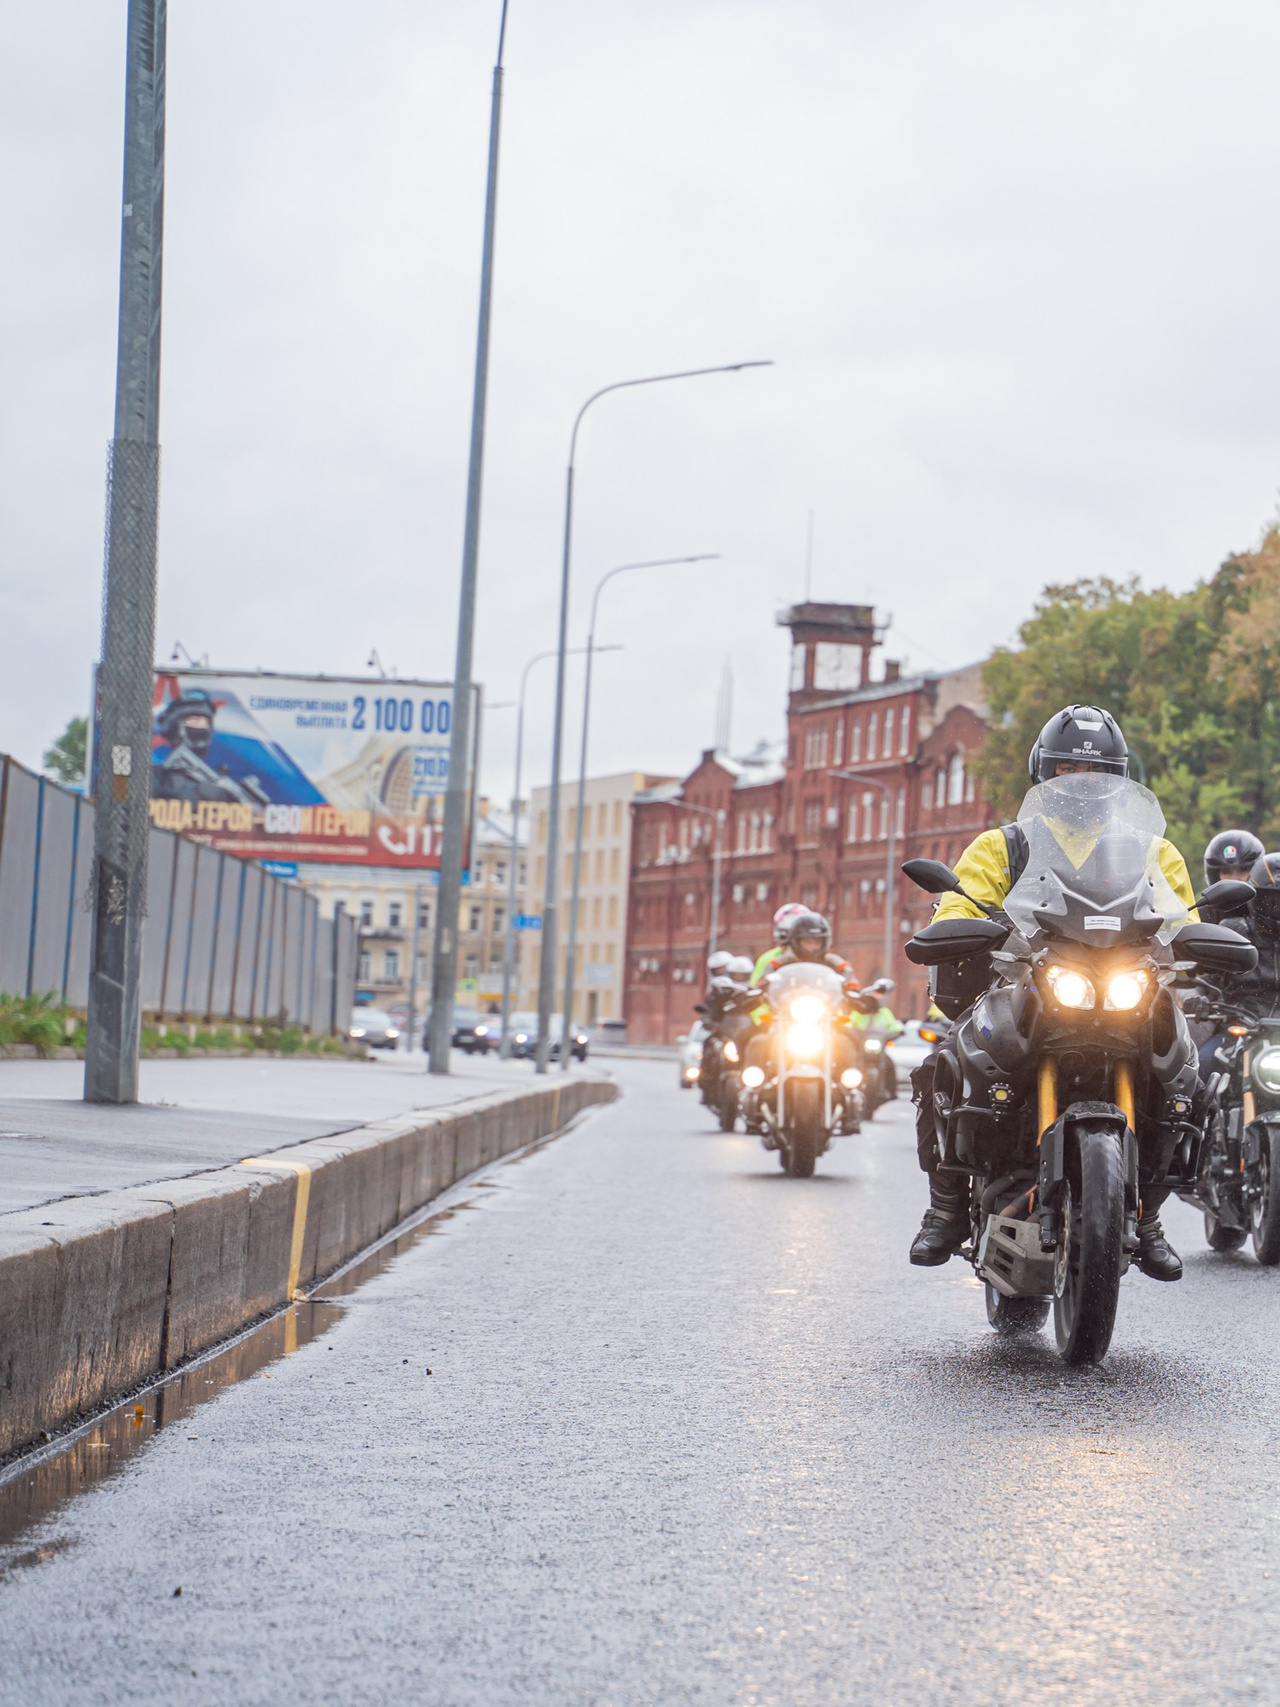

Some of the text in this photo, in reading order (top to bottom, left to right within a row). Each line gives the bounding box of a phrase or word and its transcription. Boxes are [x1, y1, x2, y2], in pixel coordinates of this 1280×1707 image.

[352, 697, 366, 731] 2
[375, 698, 413, 732] 100
[1072, 747, 1102, 757] SHARK
